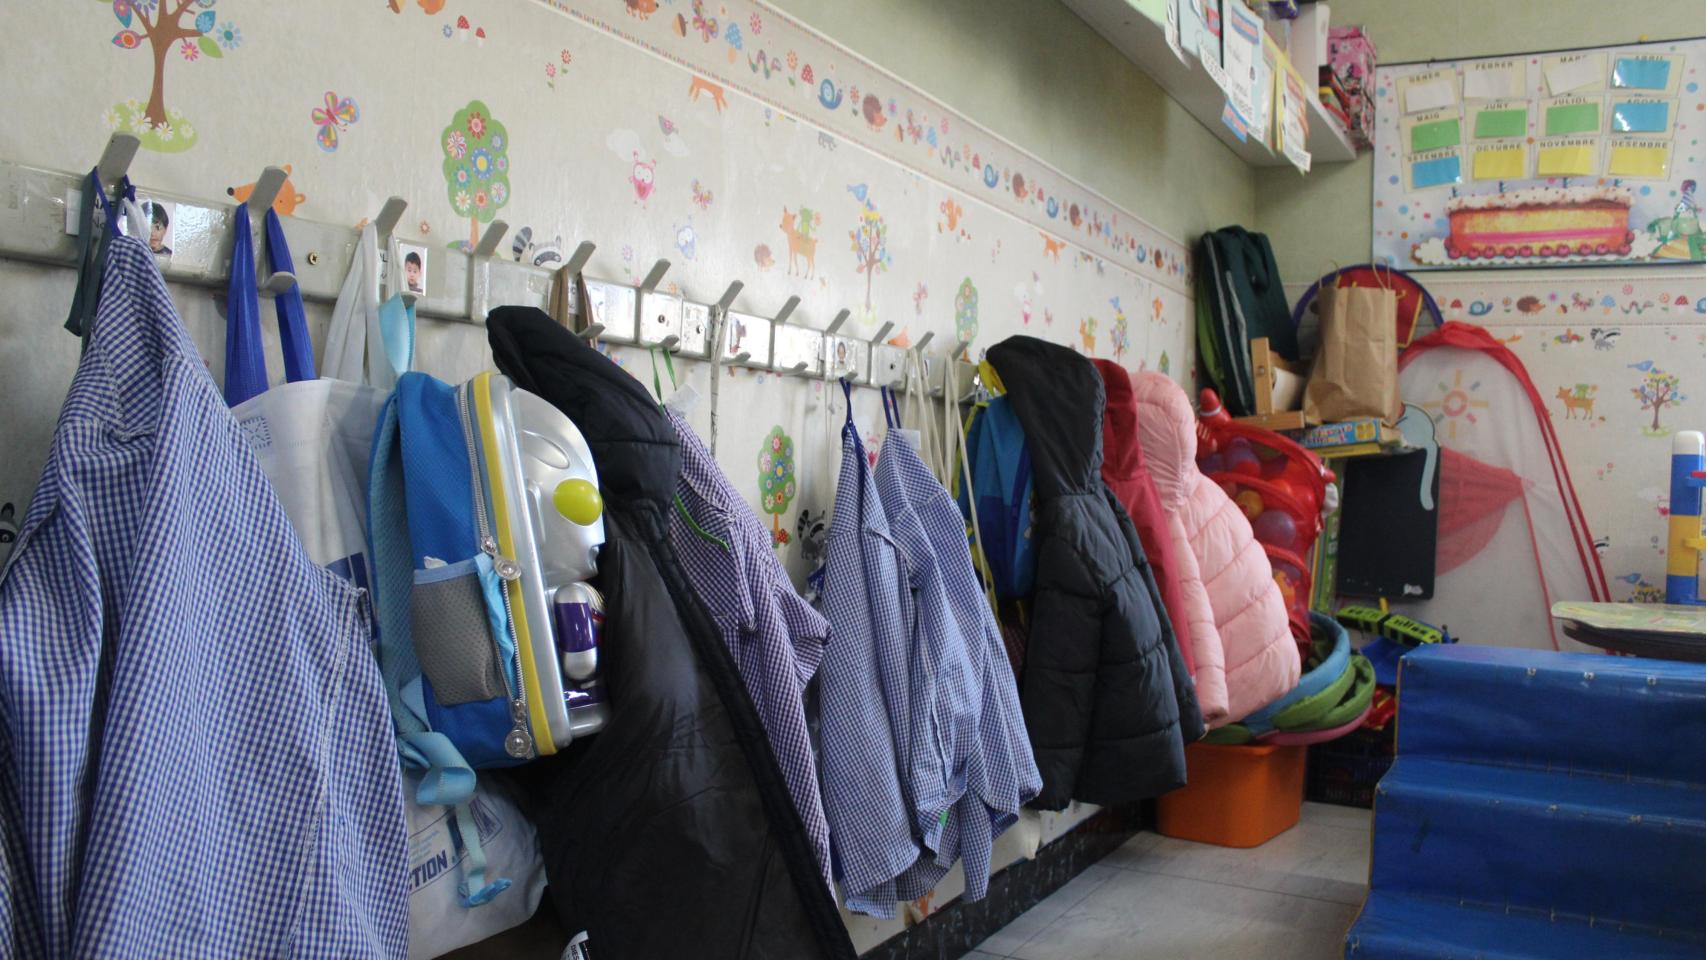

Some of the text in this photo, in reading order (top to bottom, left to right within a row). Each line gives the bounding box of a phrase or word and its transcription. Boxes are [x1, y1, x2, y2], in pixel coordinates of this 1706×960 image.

[1475, 62, 1513, 71] FEBRER
[1417, 112, 1440, 121] MAIG
[1476, 144, 1522, 152] OCTUBRE
[1540, 139, 1595, 148] NOVEMBRE
[1611, 141, 1668, 149] DESEMBRE
[1407, 150, 1457, 162] SETEMBRE
